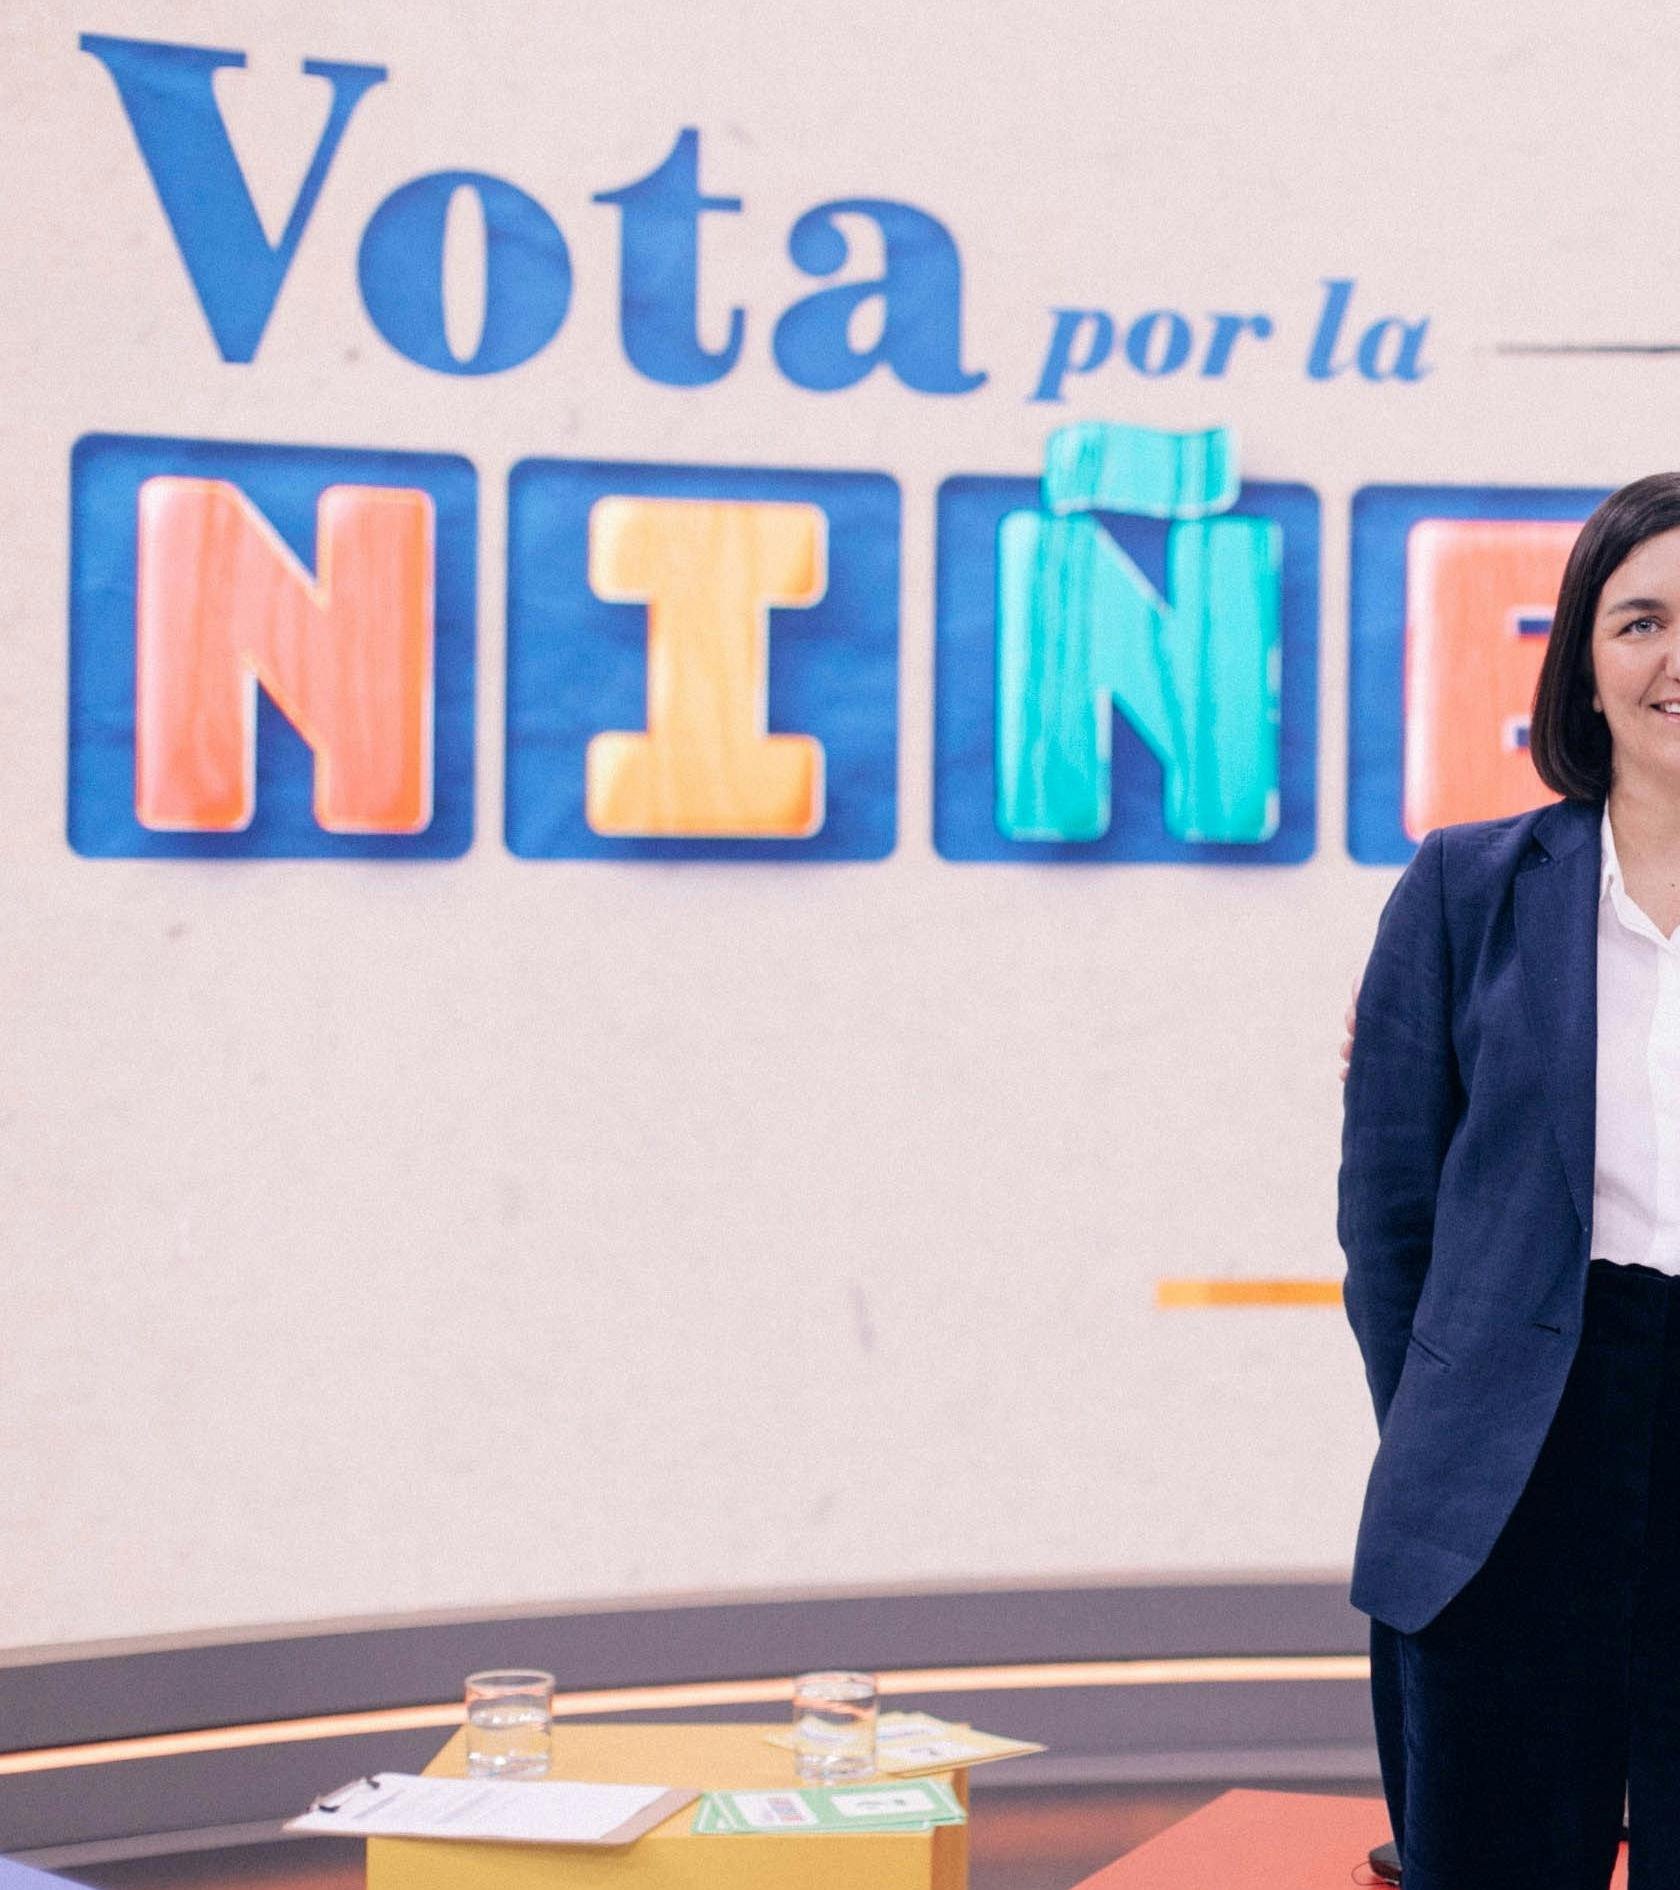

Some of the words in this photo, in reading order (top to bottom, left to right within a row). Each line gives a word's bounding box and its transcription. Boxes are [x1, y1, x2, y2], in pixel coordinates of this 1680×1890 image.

[78, 32, 990, 398] Vota
[1024, 305, 1274, 404] por
[1305, 277, 1434, 383] la
